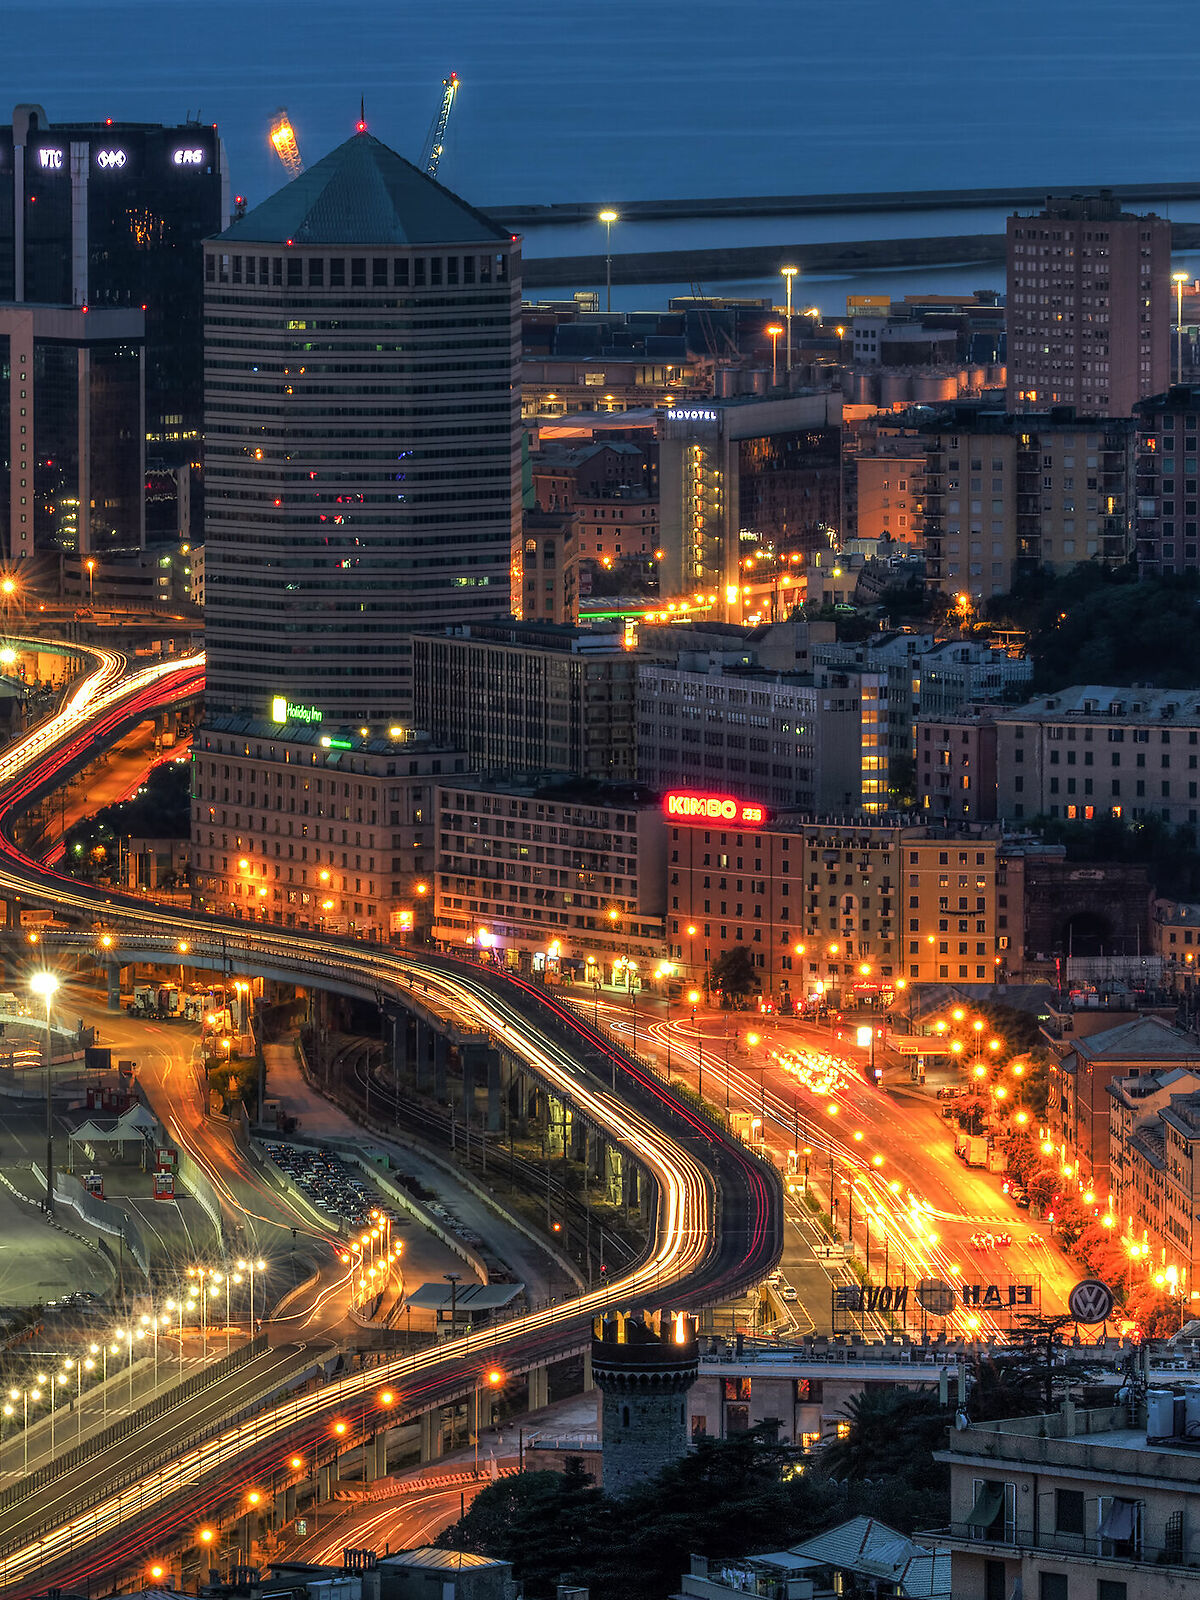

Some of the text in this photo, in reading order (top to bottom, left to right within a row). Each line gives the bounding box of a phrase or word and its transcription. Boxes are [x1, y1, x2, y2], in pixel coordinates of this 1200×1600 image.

[39, 149, 62, 168] WTC
[668, 410, 717, 421] NOVOTEL
[287, 702, 323, 723] Holiday Inn
[668, 795, 737, 819] KIMBO
